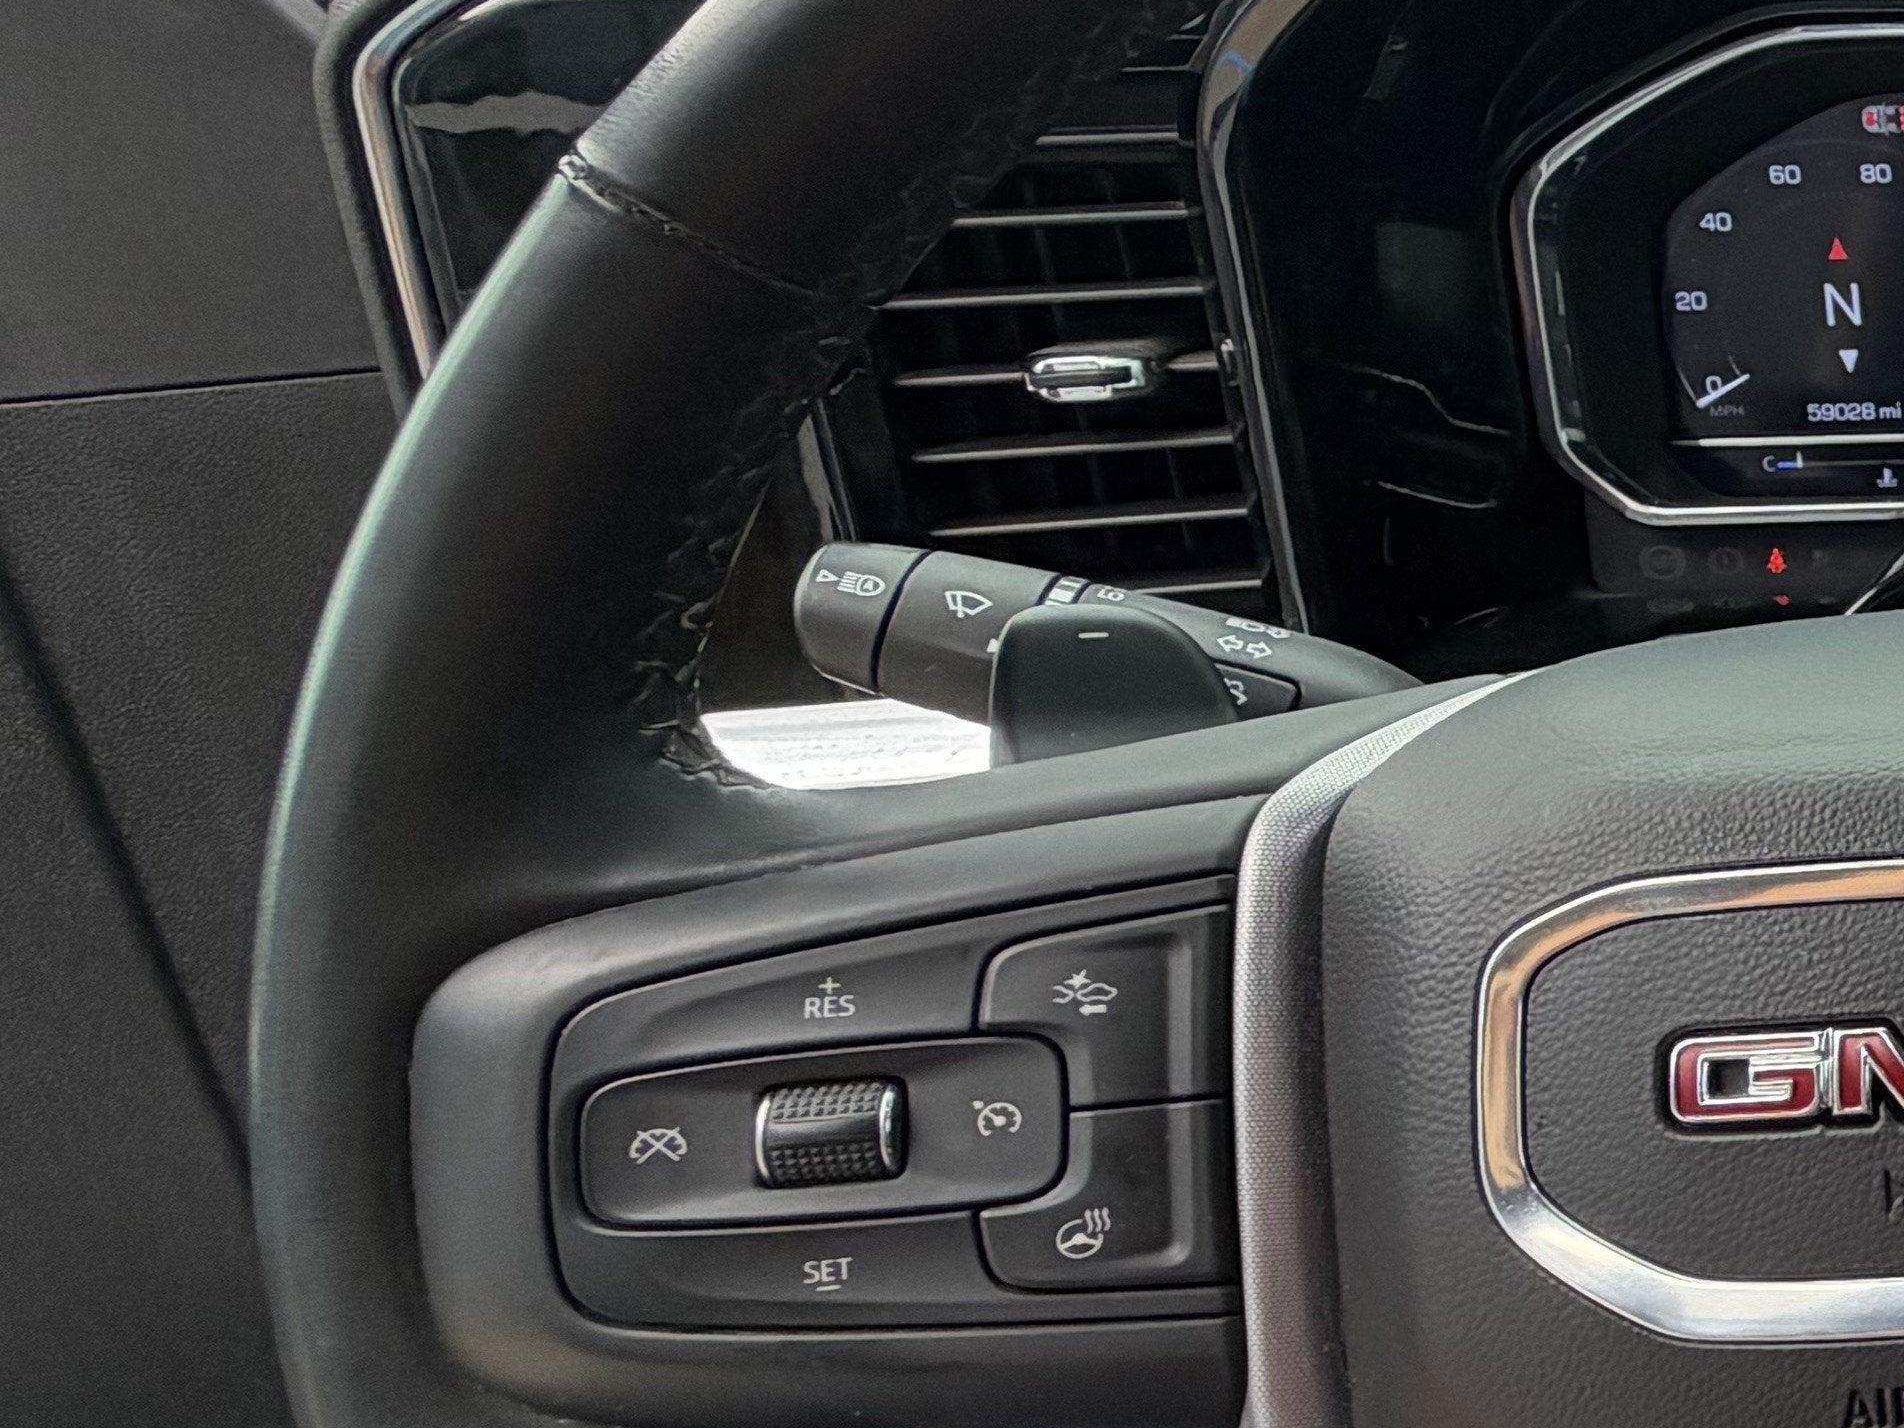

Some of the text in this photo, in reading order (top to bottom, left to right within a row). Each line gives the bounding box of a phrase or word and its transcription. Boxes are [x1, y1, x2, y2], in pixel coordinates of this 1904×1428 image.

[1769, 165, 1801, 185] 60
[1859, 163, 1892, 184] 80
[1699, 212, 1733, 232] 40
[1674, 291, 1708, 311] 20
[1823, 282, 1863, 326] N
[1806, 400, 1902, 422] 59028 mi
[1762, 456, 1776, 473] C
[804, 994, 856, 1020] RES
[803, 1256, 854, 1285] SET
